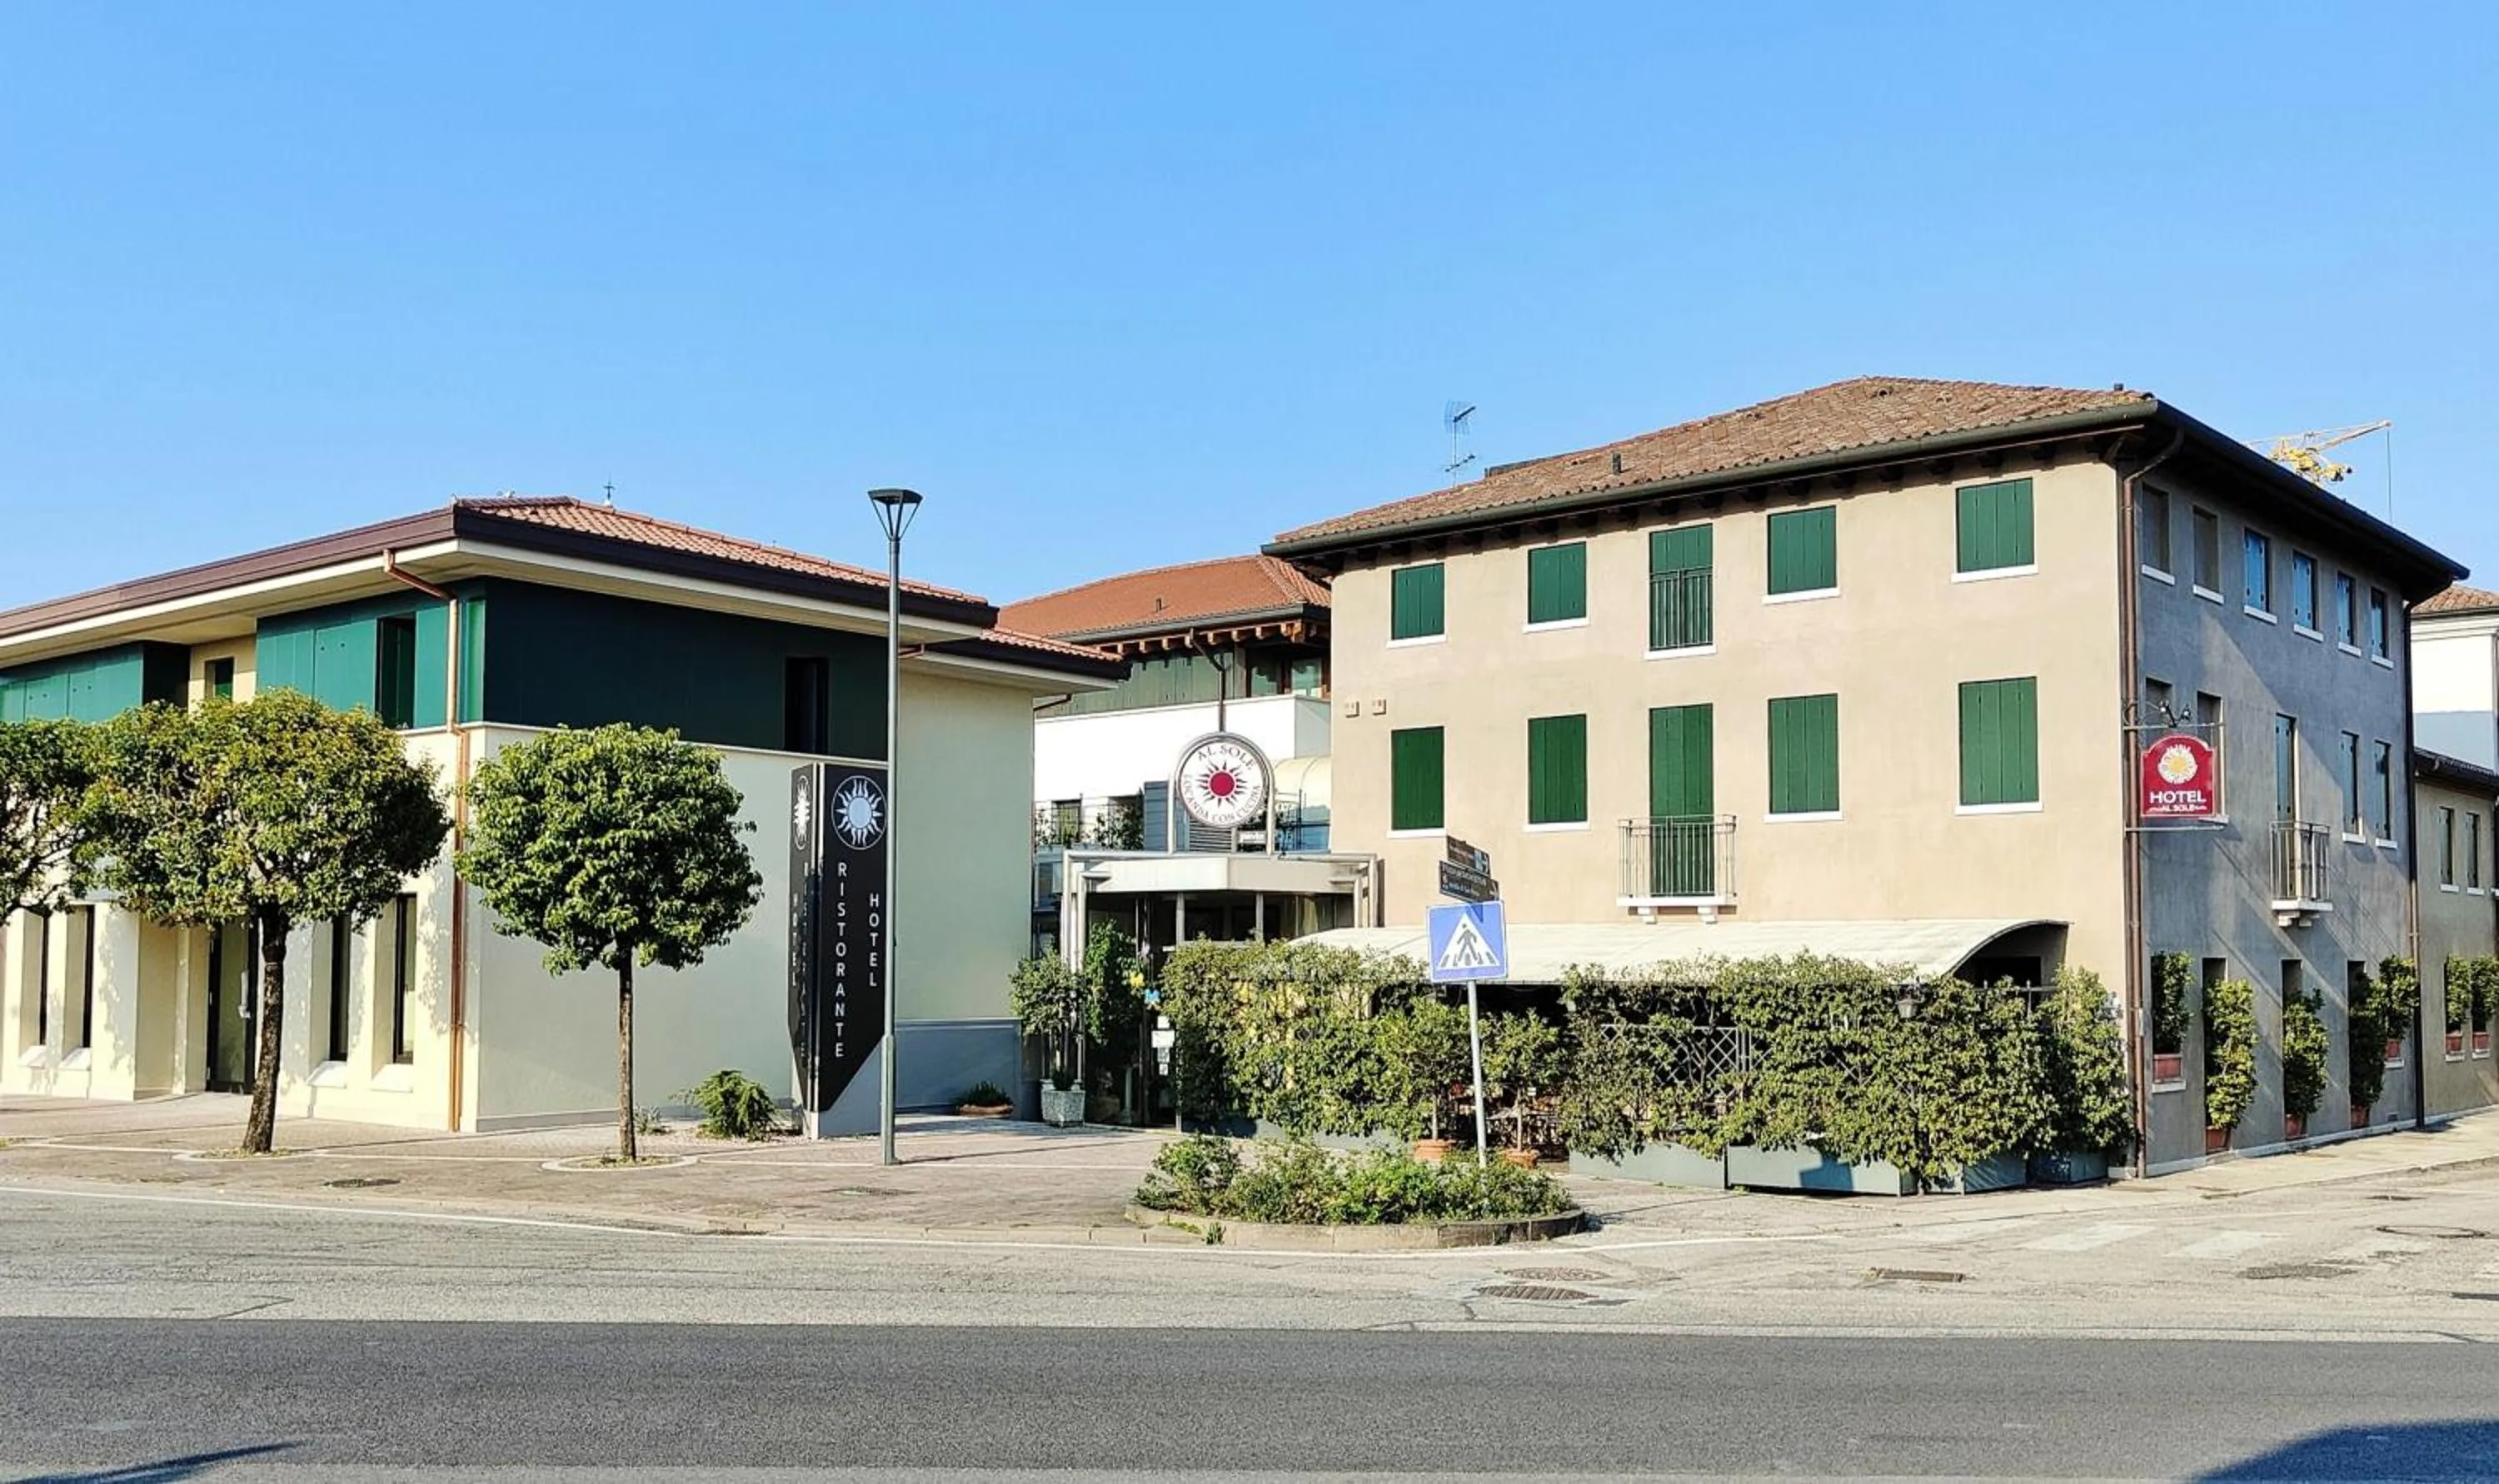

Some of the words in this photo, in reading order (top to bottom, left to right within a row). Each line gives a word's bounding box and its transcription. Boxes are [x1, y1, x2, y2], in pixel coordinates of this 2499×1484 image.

[1198, 745, 1216, 761] AL
[1219, 744, 1254, 769] SOLE
[2149, 789, 2207, 804] HOTEL
[834, 861, 848, 1058] RISTORANTE
[868, 892, 880, 988] HOTEL
